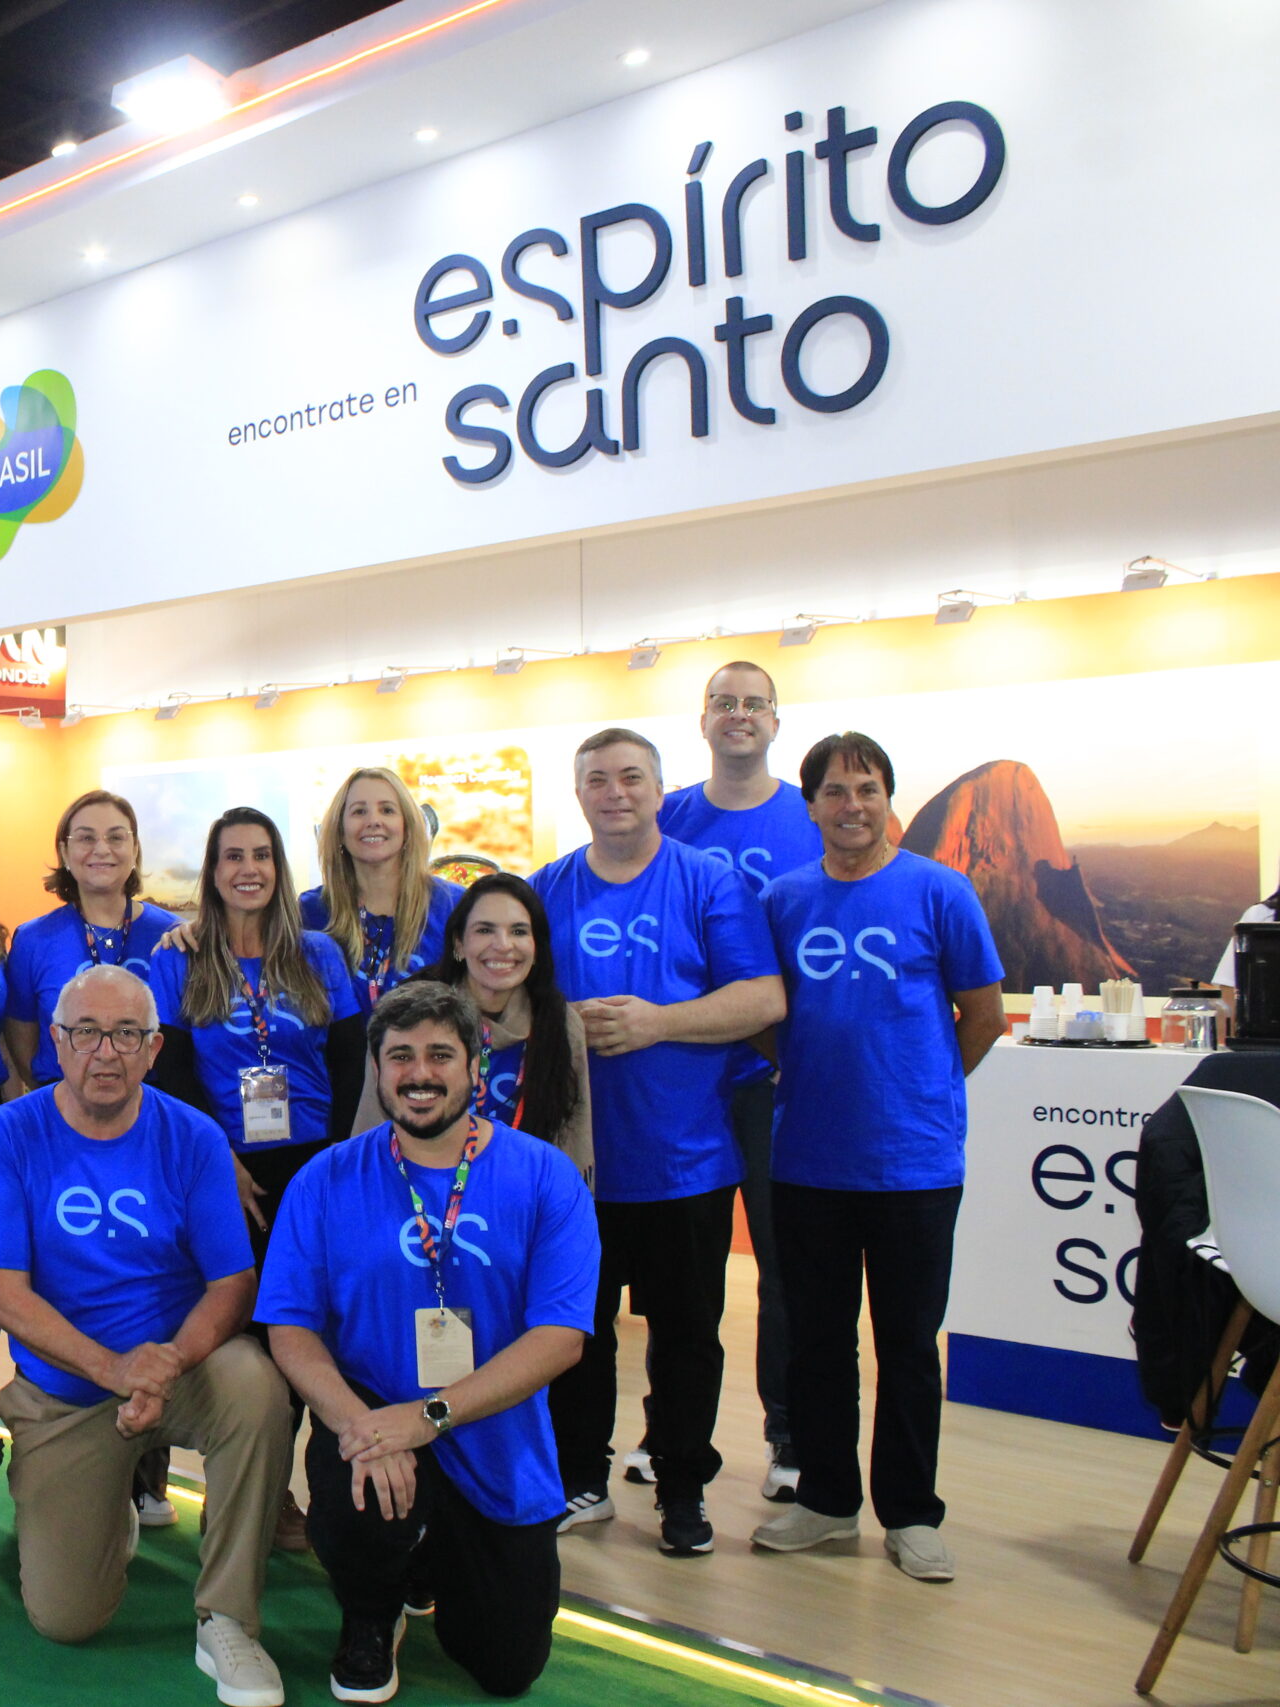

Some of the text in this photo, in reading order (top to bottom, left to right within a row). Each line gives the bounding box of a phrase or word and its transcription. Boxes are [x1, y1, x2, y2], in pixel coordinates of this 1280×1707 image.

[228, 381, 418, 446] encontrate en
[442, 295, 890, 486] santo
